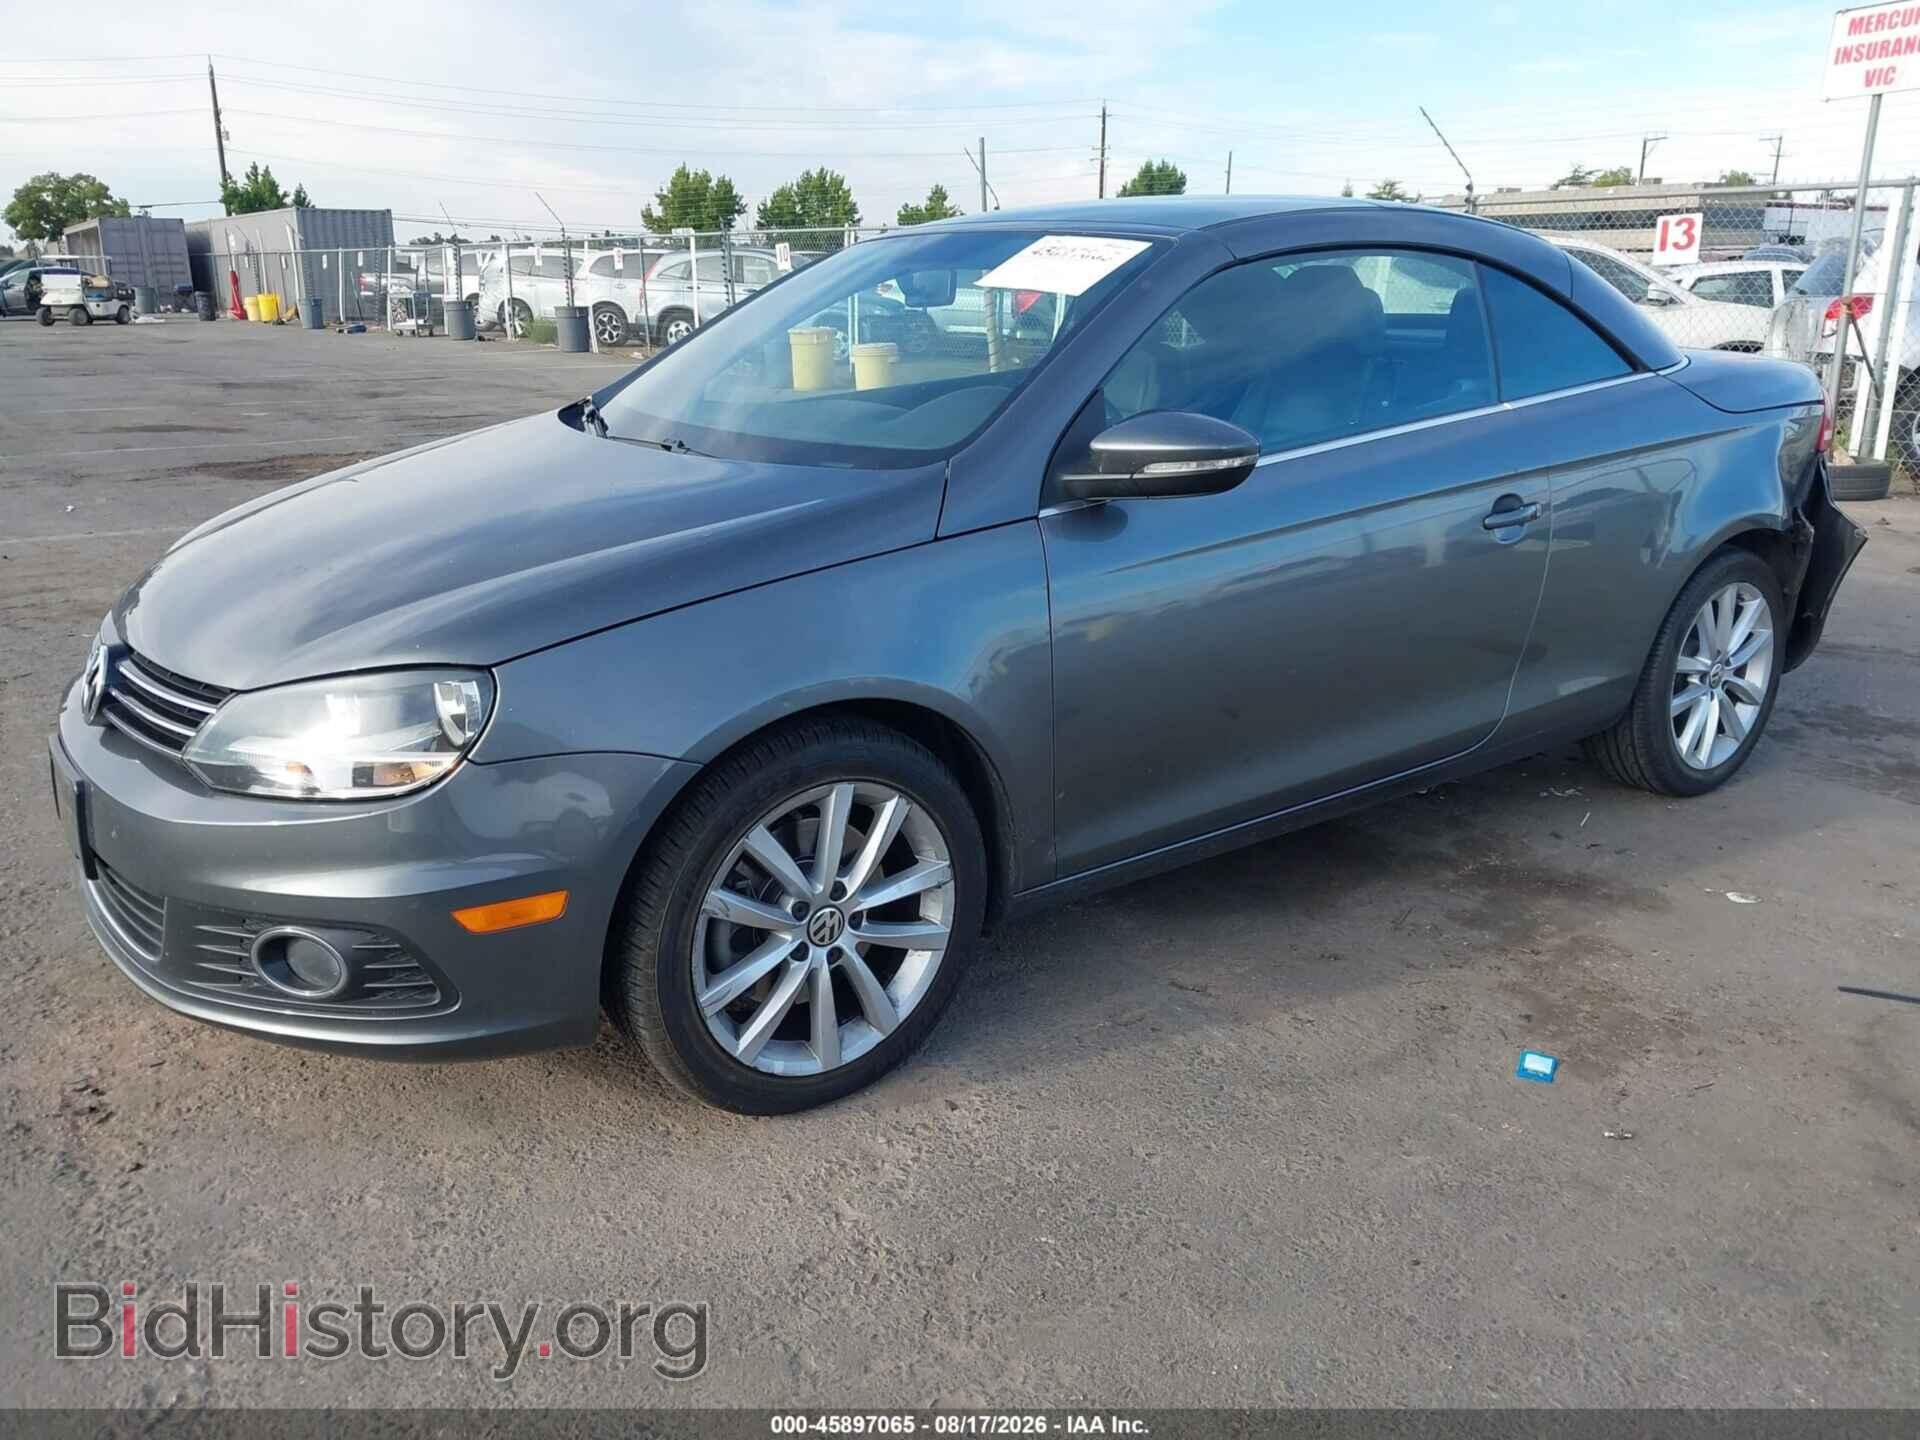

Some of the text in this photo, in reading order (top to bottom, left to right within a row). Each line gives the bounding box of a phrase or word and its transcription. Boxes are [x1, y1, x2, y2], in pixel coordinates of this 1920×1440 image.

[1834, 35, 1920, 65] INSURAN
[1865, 66, 1896, 88] VIC
[1659, 218, 1696, 252] 13
